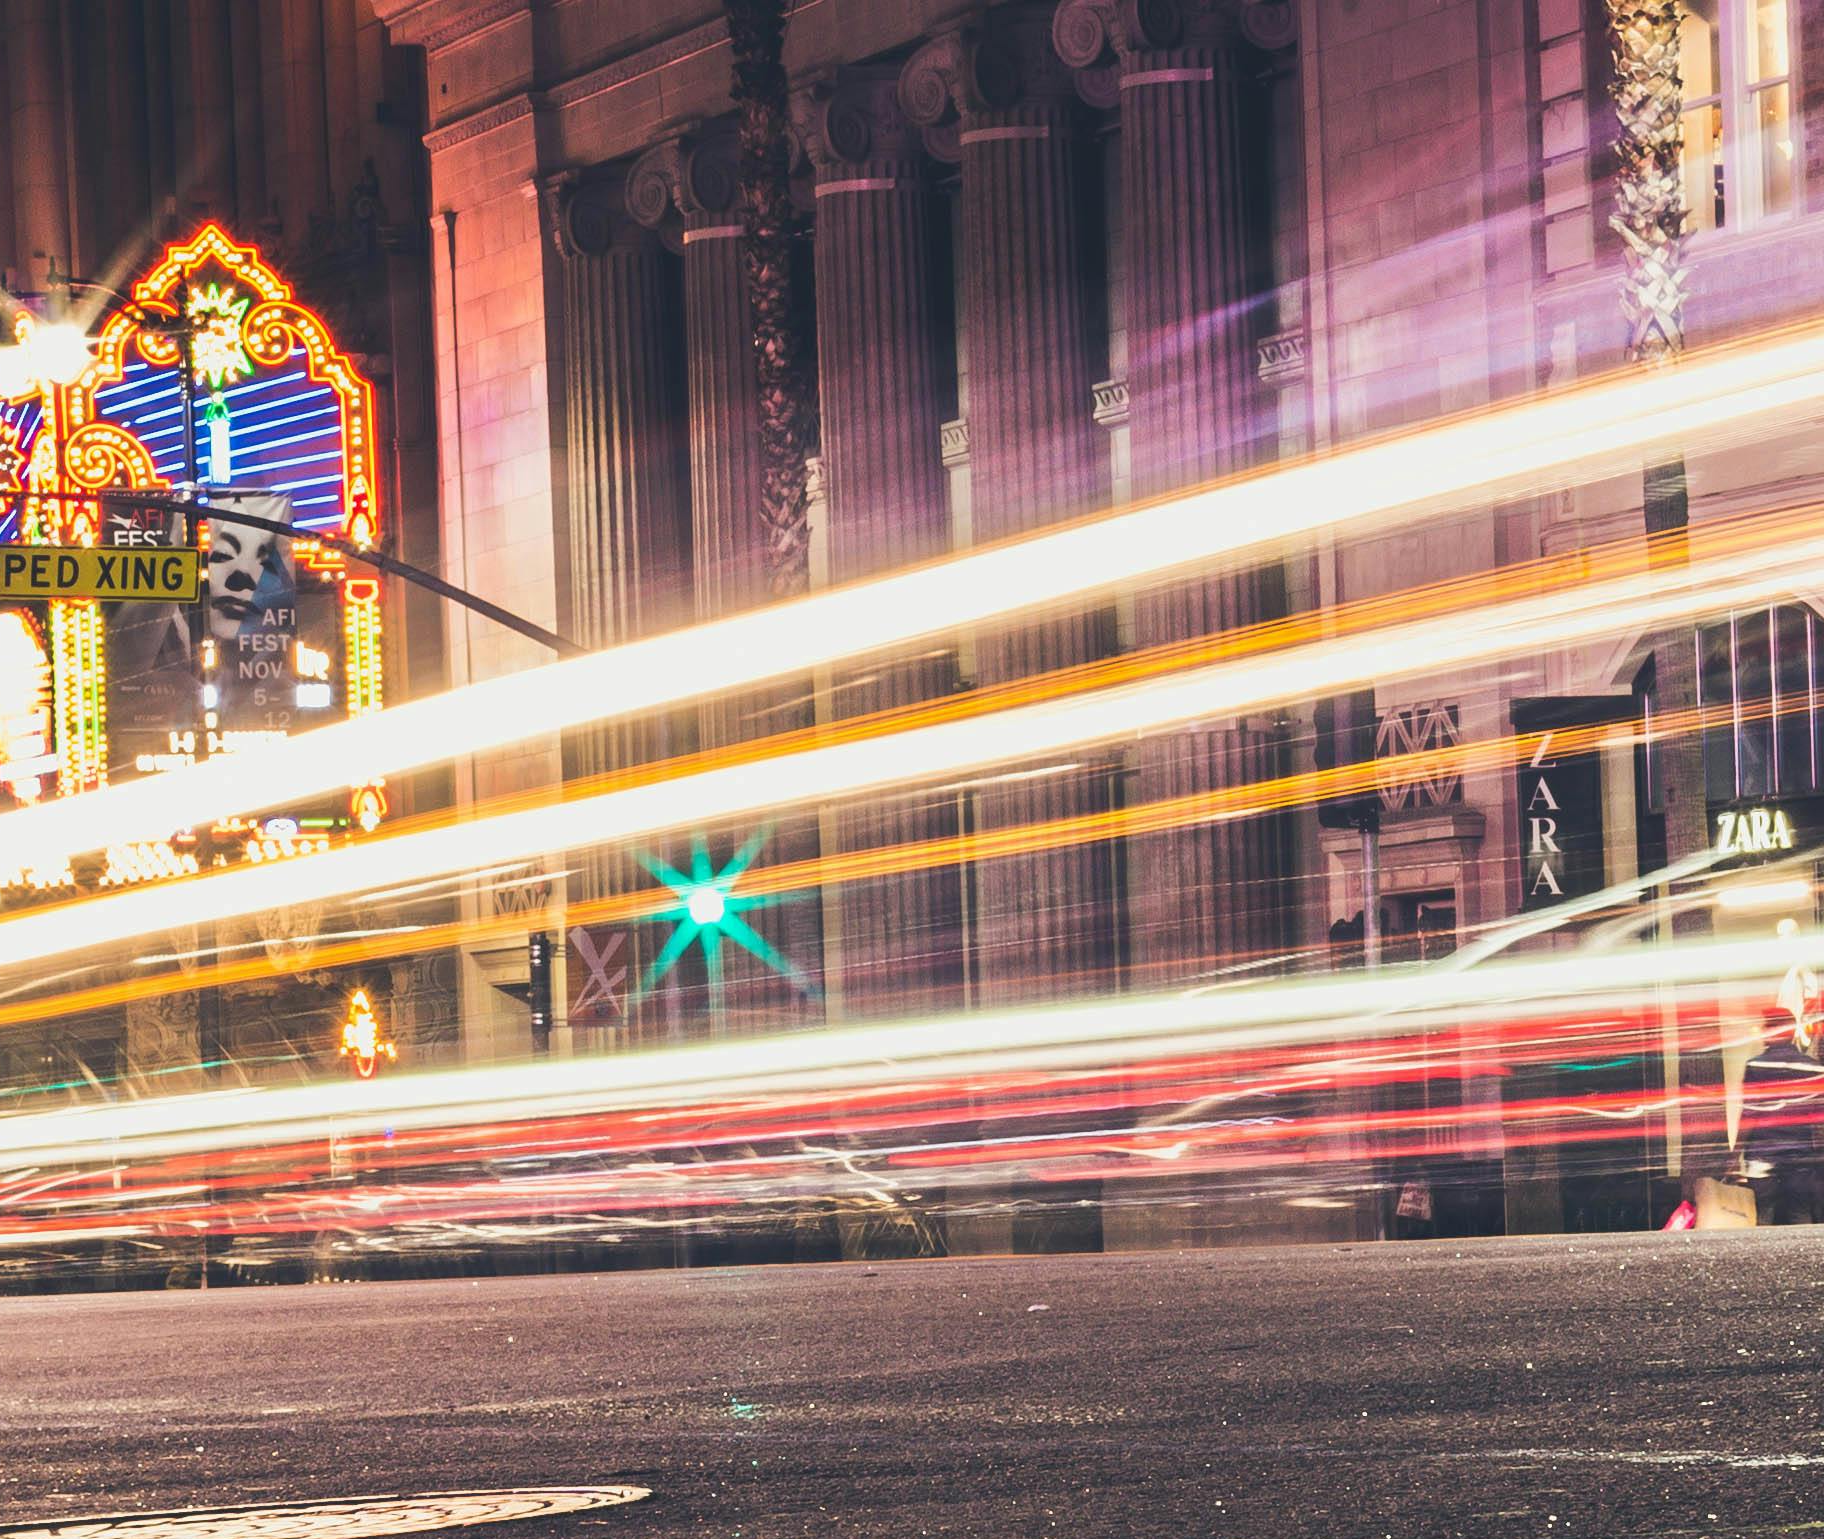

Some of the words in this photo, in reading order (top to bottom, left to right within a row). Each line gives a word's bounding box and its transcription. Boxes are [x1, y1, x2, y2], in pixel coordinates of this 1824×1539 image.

[130, 509, 164, 529] AFI
[4, 553, 80, 589] PED
[95, 556, 184, 592] XING
[262, 608, 296, 626] AFI
[238, 633, 290, 652] FEST
[238, 661, 283, 679] NOV
[1527, 732, 1564, 896] ZARA
[1717, 807, 1793, 853] ZARA
